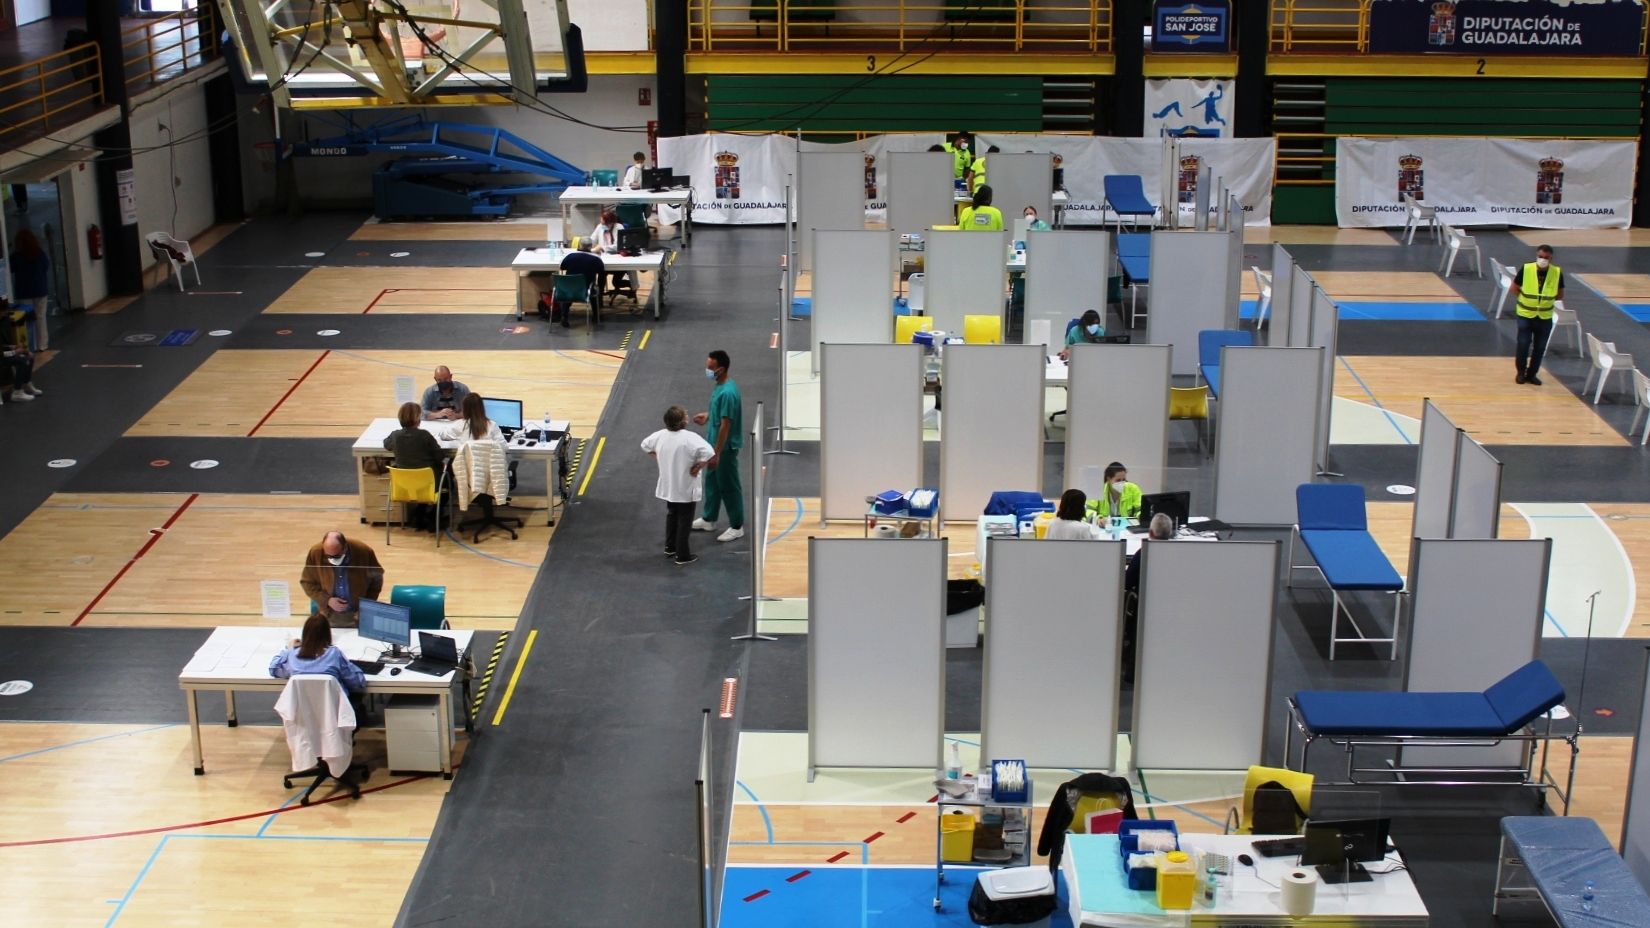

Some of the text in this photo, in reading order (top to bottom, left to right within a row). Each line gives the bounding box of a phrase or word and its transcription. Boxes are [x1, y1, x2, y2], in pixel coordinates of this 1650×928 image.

[1165, 21, 1216, 32] SAN JOSÉ
[1463, 15, 1580, 31] DIPUTACIÓN DE
[1461, 31, 1582, 45] GUADALAJARA
[867, 55, 875, 71] 3
[1476, 59, 1486, 75] 2
[733, 202, 788, 210] GUADALAJAR
[1352, 205, 1405, 213] DIPUTACIÓN
[1491, 205, 1543, 214] DIPUTACIÓN
[1554, 207, 1615, 215] GUADALAJARA
